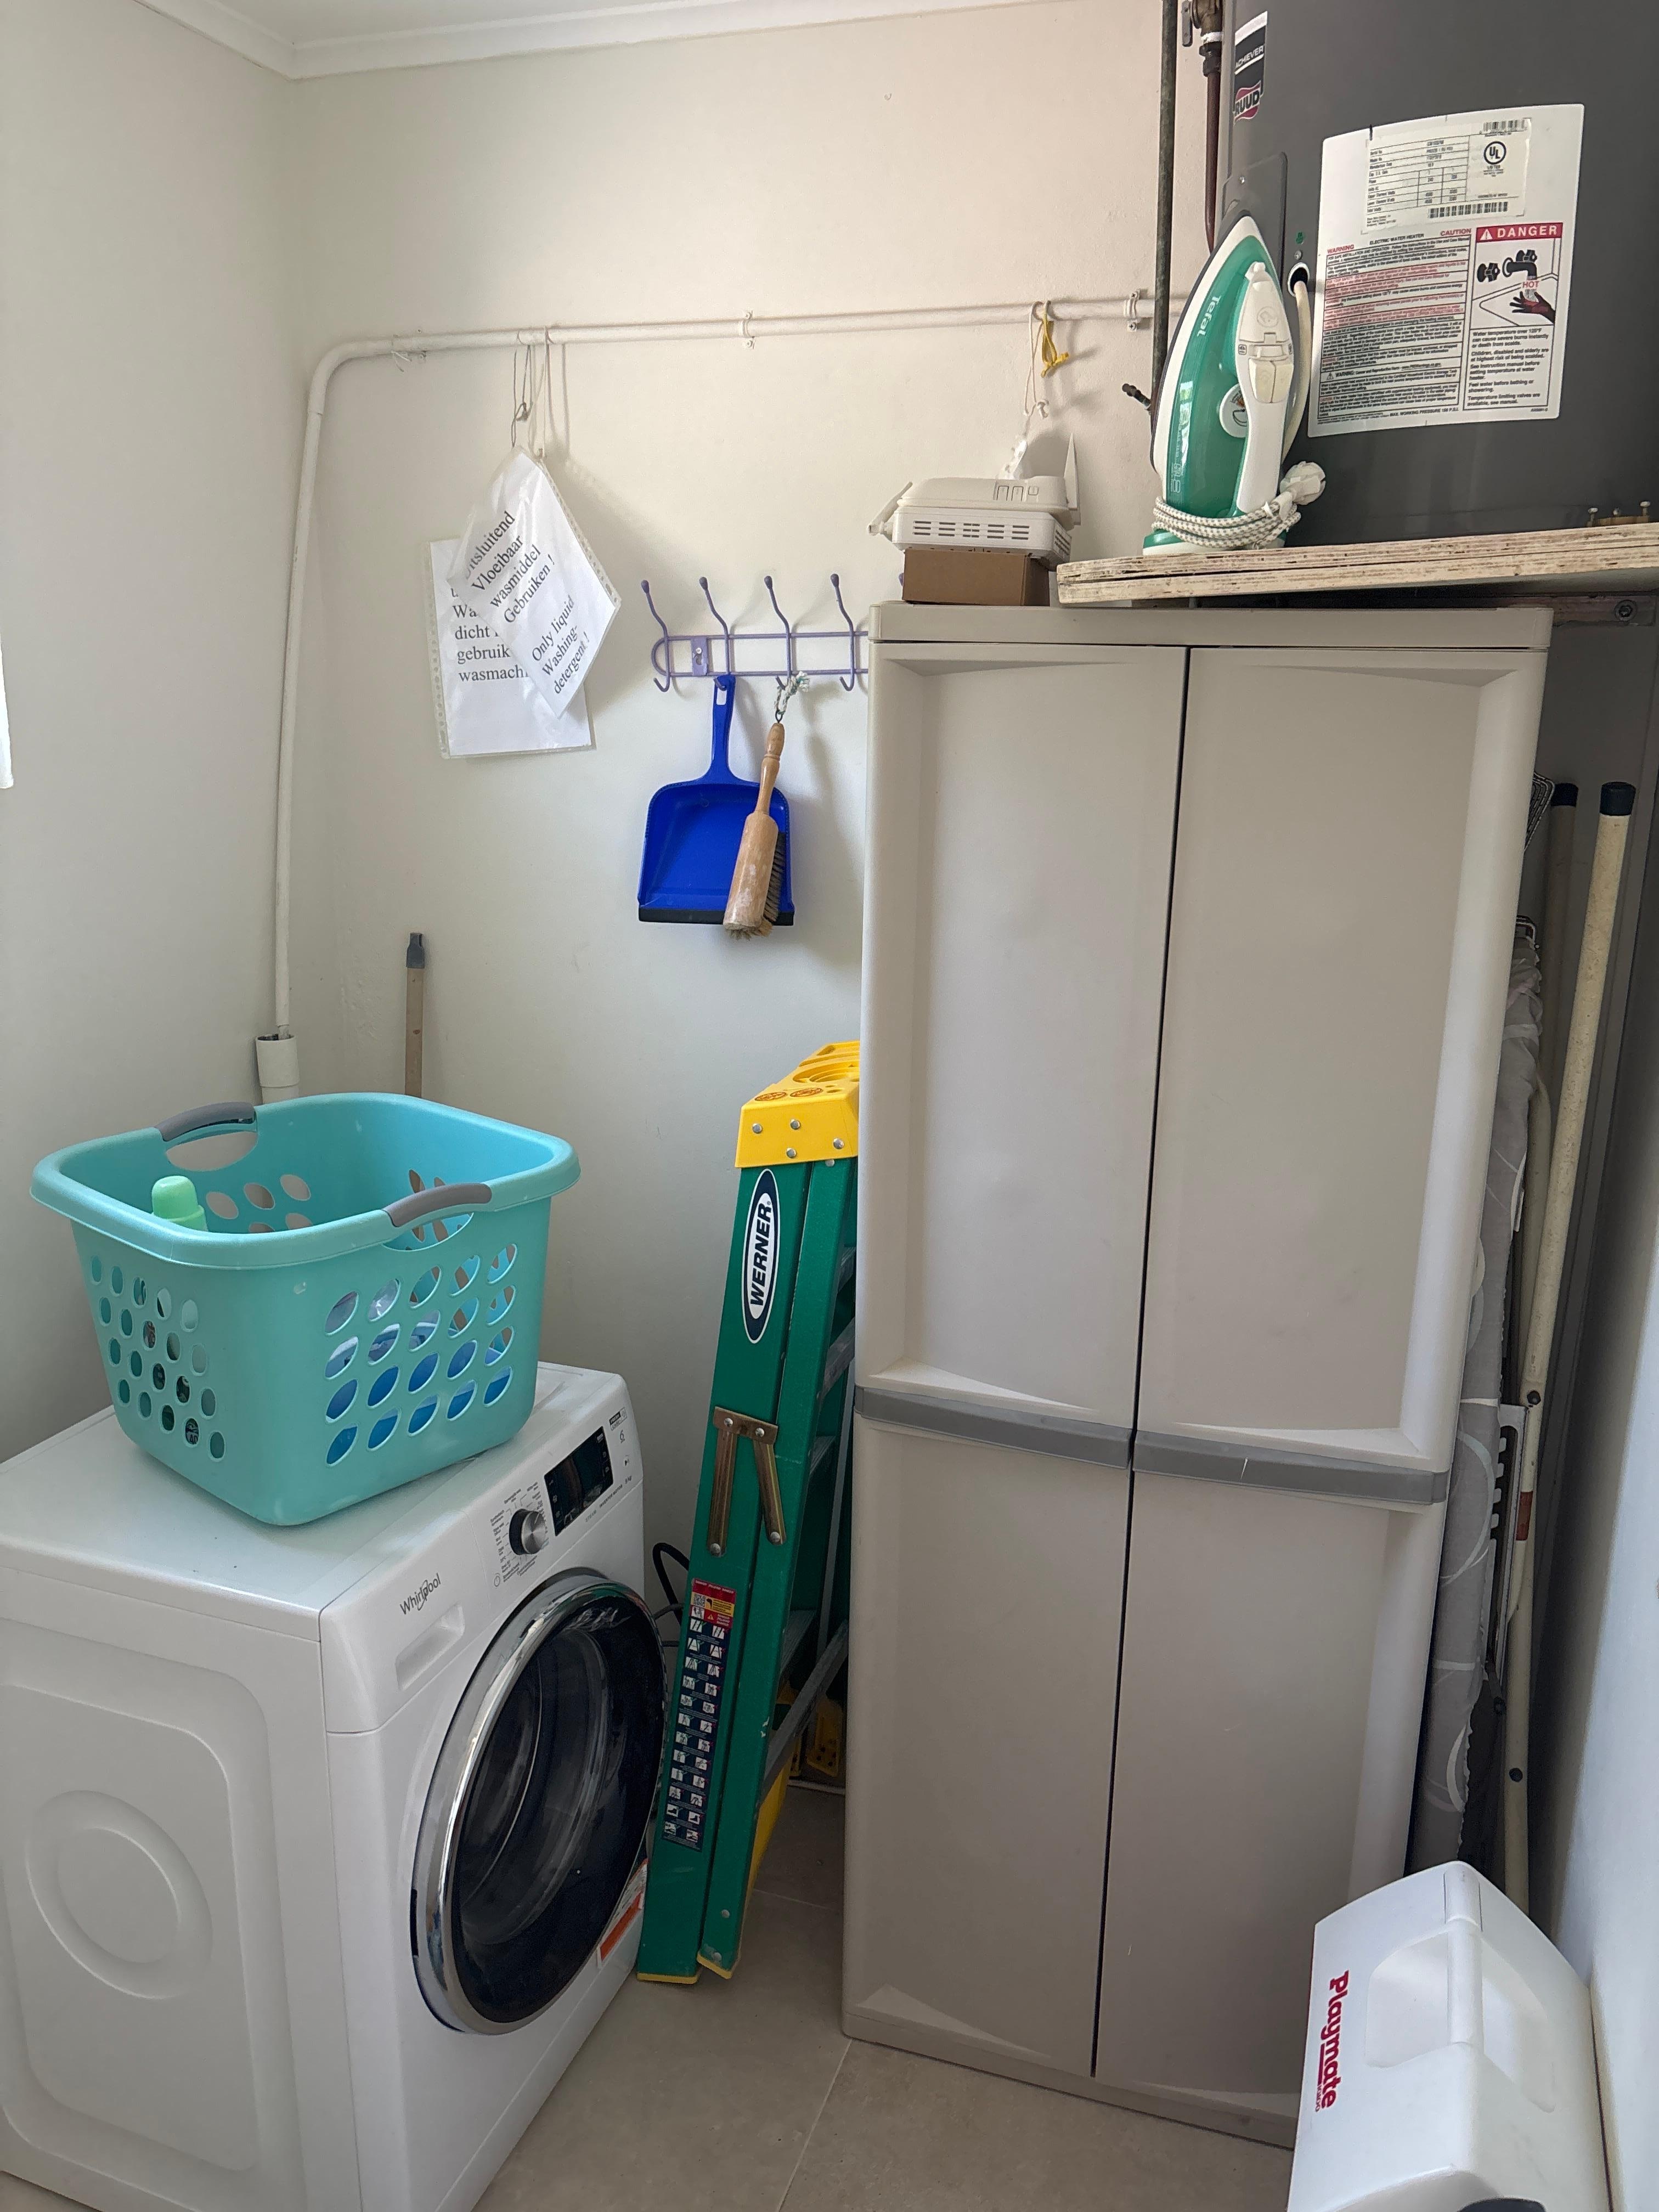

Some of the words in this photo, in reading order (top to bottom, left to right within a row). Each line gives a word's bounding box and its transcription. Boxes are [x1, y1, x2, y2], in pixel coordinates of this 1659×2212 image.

[1235, 45, 1264, 68] ACHIEVER
[1235, 90, 1260, 115] RUUD
[1489, 146, 1500, 159] UL
[1327, 245, 1355, 253] WARNING
[1497, 225, 1557, 238] DANGER
[1197, 295, 1222, 337] Tefal
[471, 535, 523, 590] Vloeibaar
[490, 544, 541, 608] wasmiddel
[504, 565, 551, 623] Gebruiken
[548, 554, 555, 566] !
[452, 604, 477, 618] Wa
[532, 631, 554, 661] Only
[551, 594, 574, 634] liquid
[455, 625, 490, 640] dicht
[542, 625, 578, 676] Washing-
[457, 644, 511, 664] gebruik
[459, 664, 529, 682] wasmach
[554, 640, 588, 694] detergent
[751, 1202, 772, 1306] WERNER
[399, 1572, 441, 1615] Whirlpool
[1321, 1969, 1349, 2109] Playmate
